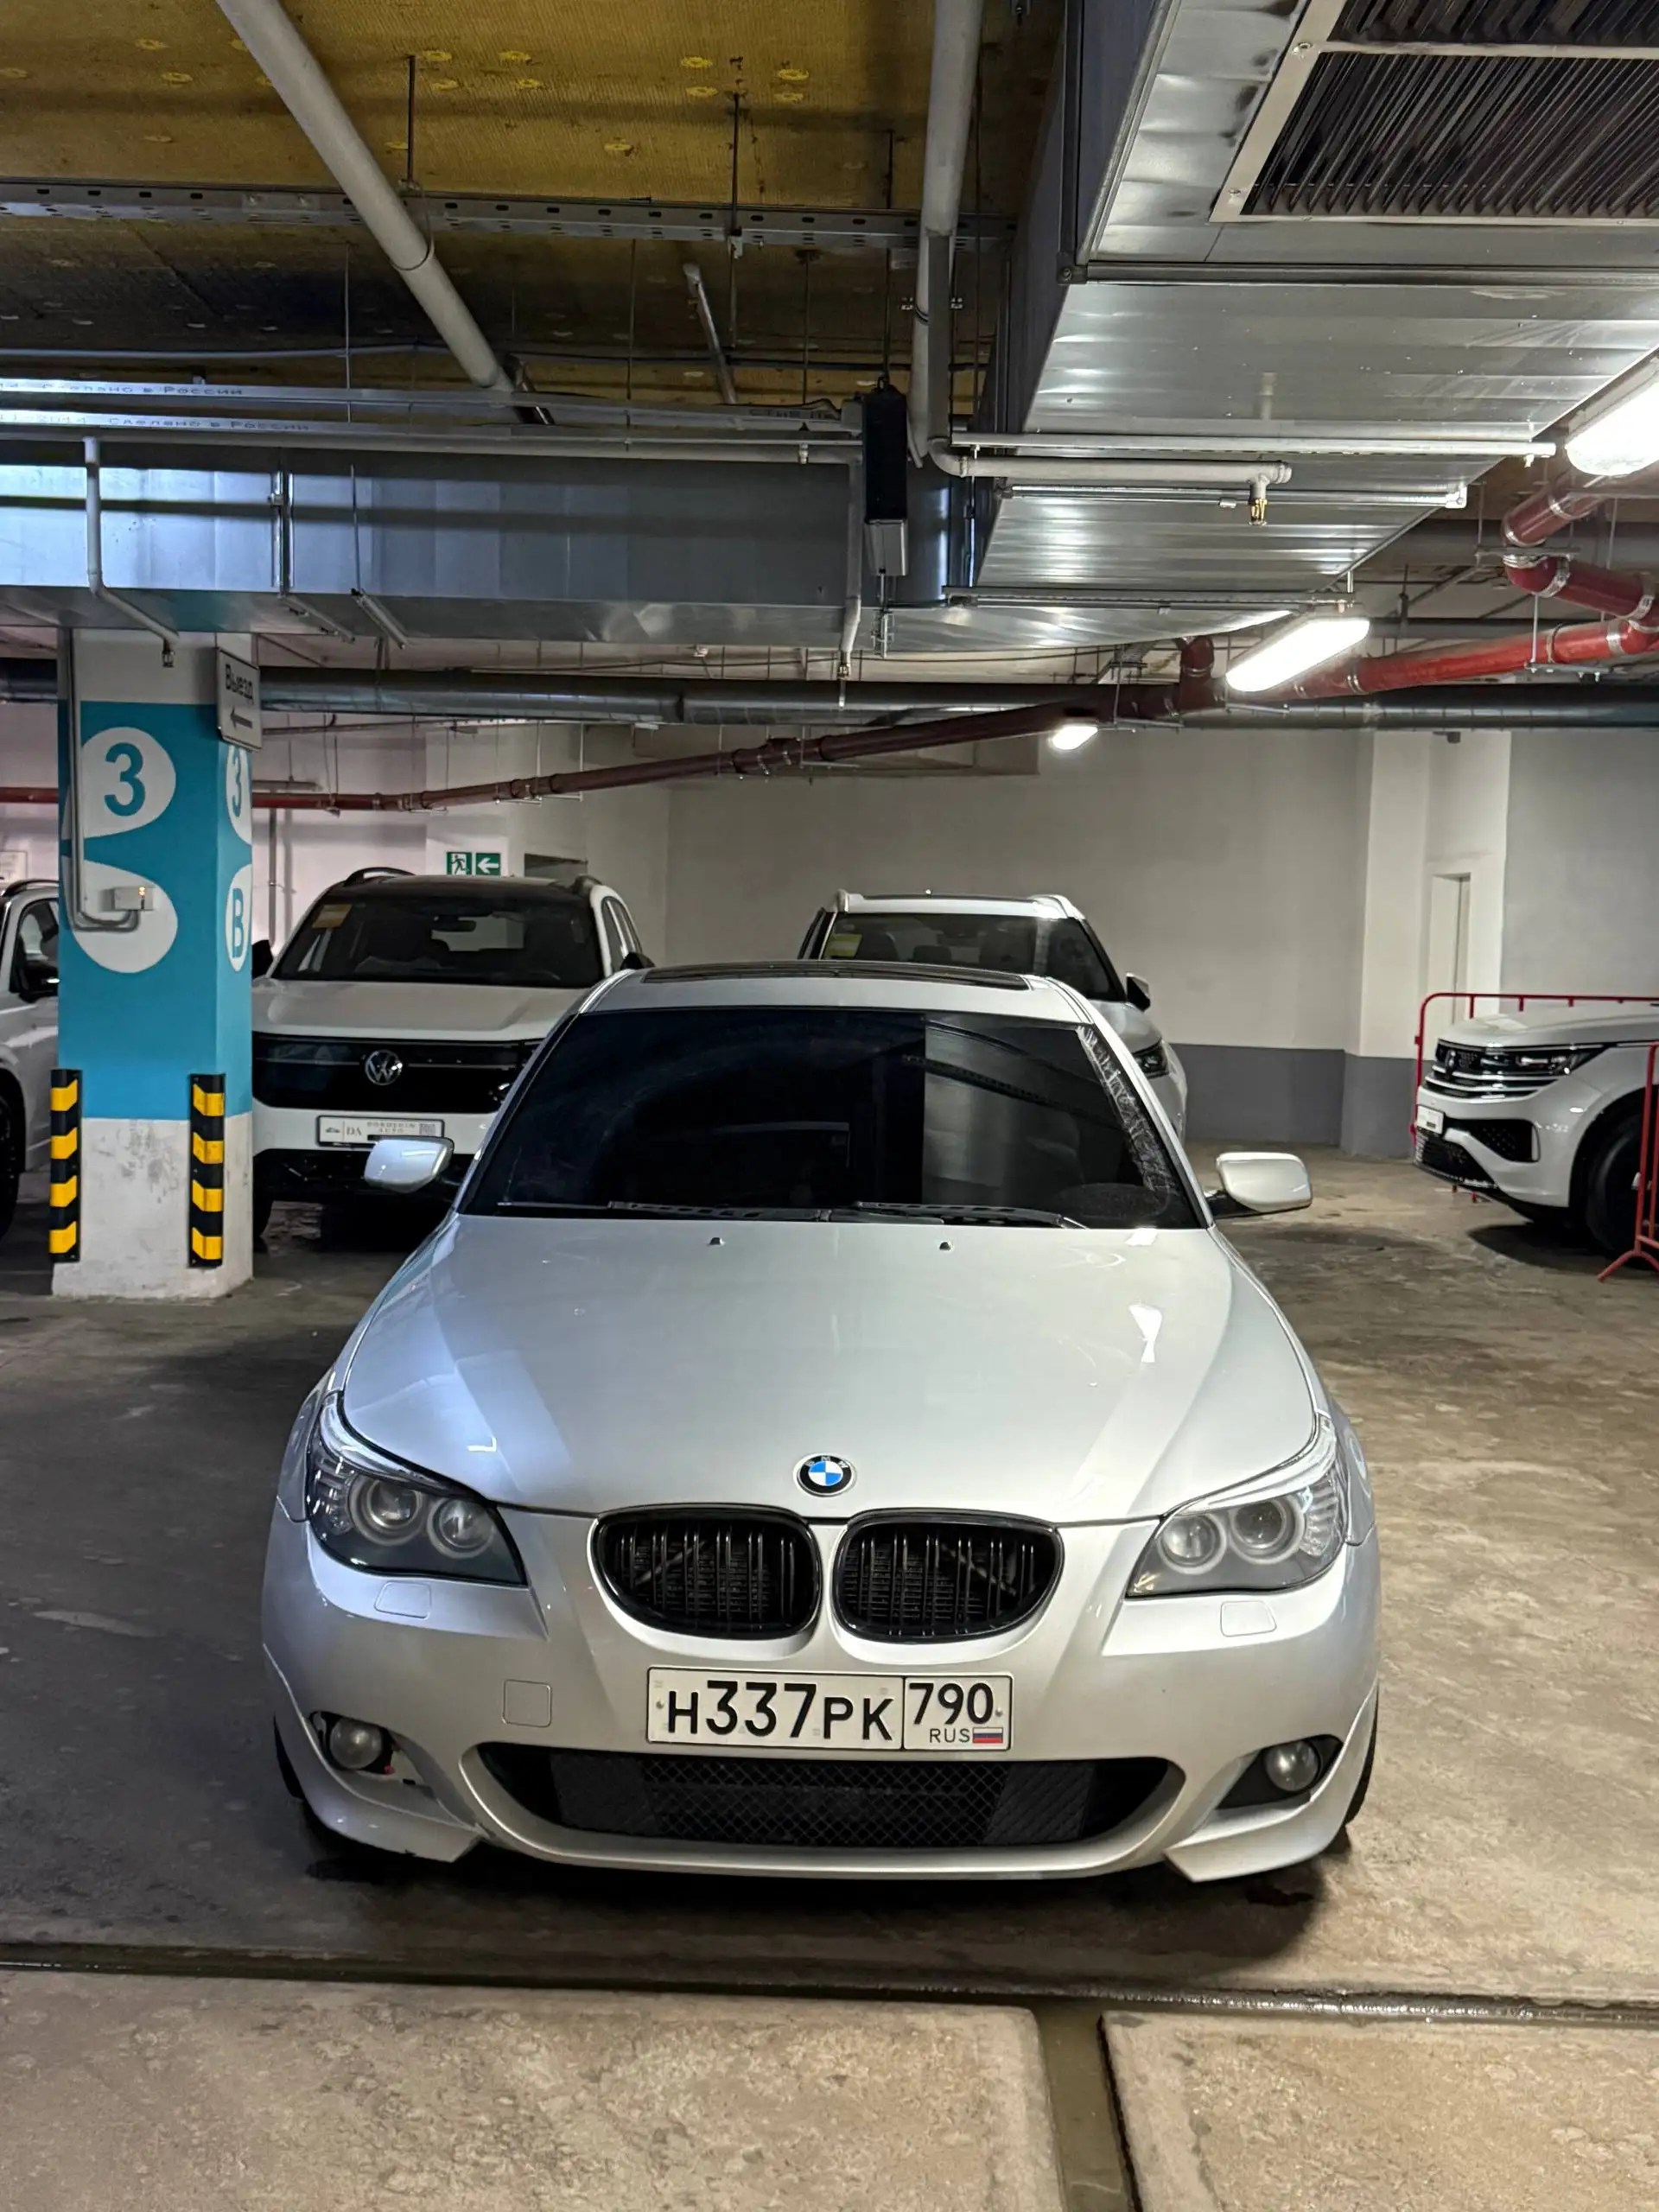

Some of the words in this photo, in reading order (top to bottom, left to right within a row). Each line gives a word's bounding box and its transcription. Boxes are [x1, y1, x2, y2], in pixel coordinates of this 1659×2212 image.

[226, 663, 254, 705] Выезд
[104, 742, 146, 817] 3
[232, 745, 243, 817] 3
[804, 1455, 849, 1469] BMW
[909, 1682, 995, 1725] 790
[929, 1728, 970, 1744] RUS
